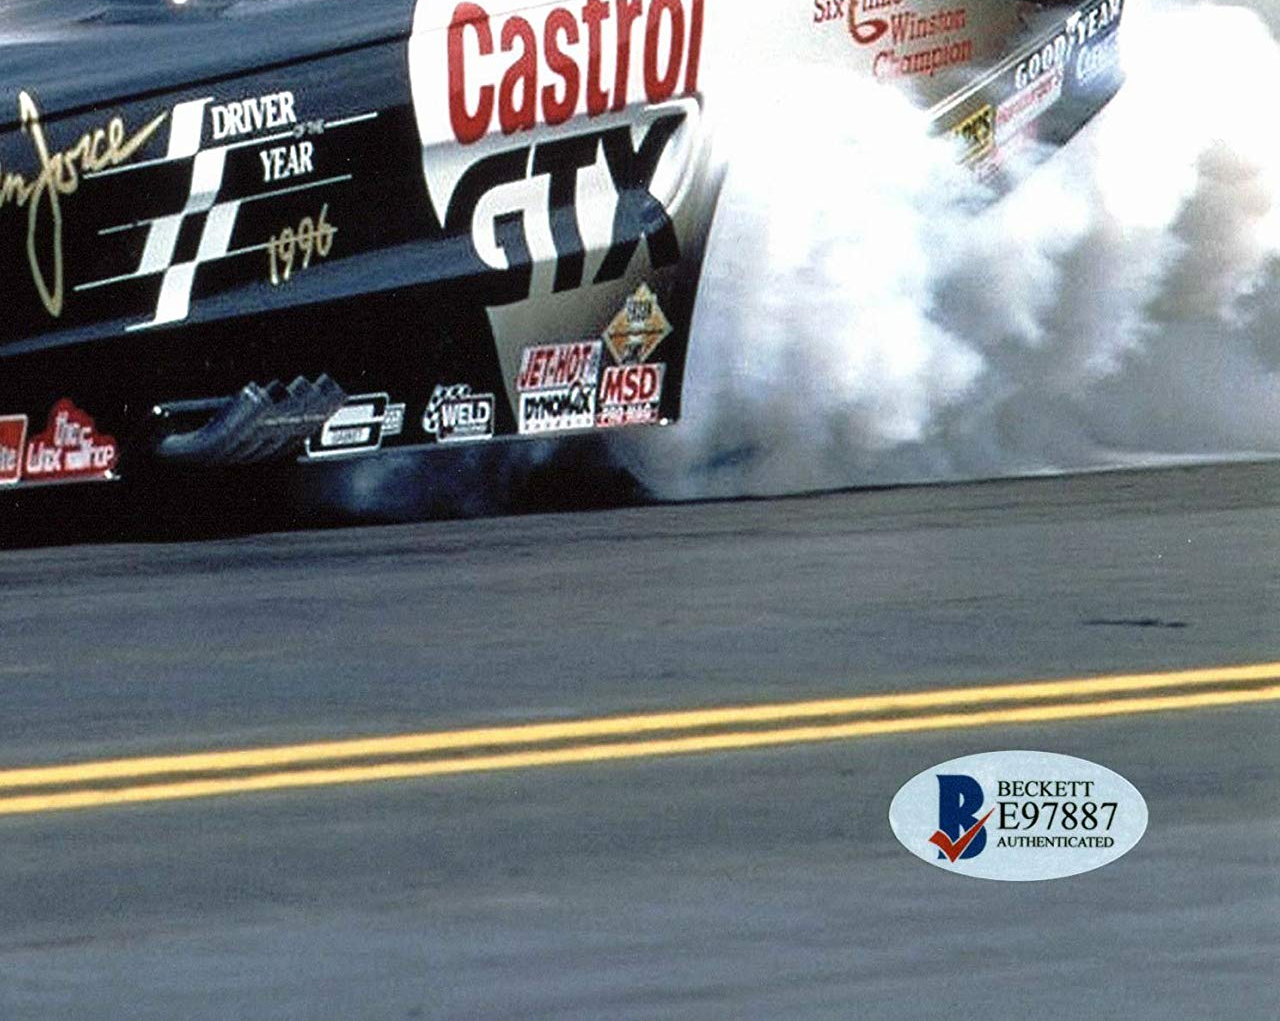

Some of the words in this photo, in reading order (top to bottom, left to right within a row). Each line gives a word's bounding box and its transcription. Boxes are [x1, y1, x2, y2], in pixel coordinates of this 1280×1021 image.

[890, 8, 967, 45] Winston
[211, 90, 297, 140] DRIVER
[259, 141, 314, 183] YEAR
[444, 112, 688, 298] GTX
[267, 203, 336, 285] 1996
[602, 365, 659, 403] MSD
[441, 401, 491, 427] WELD
